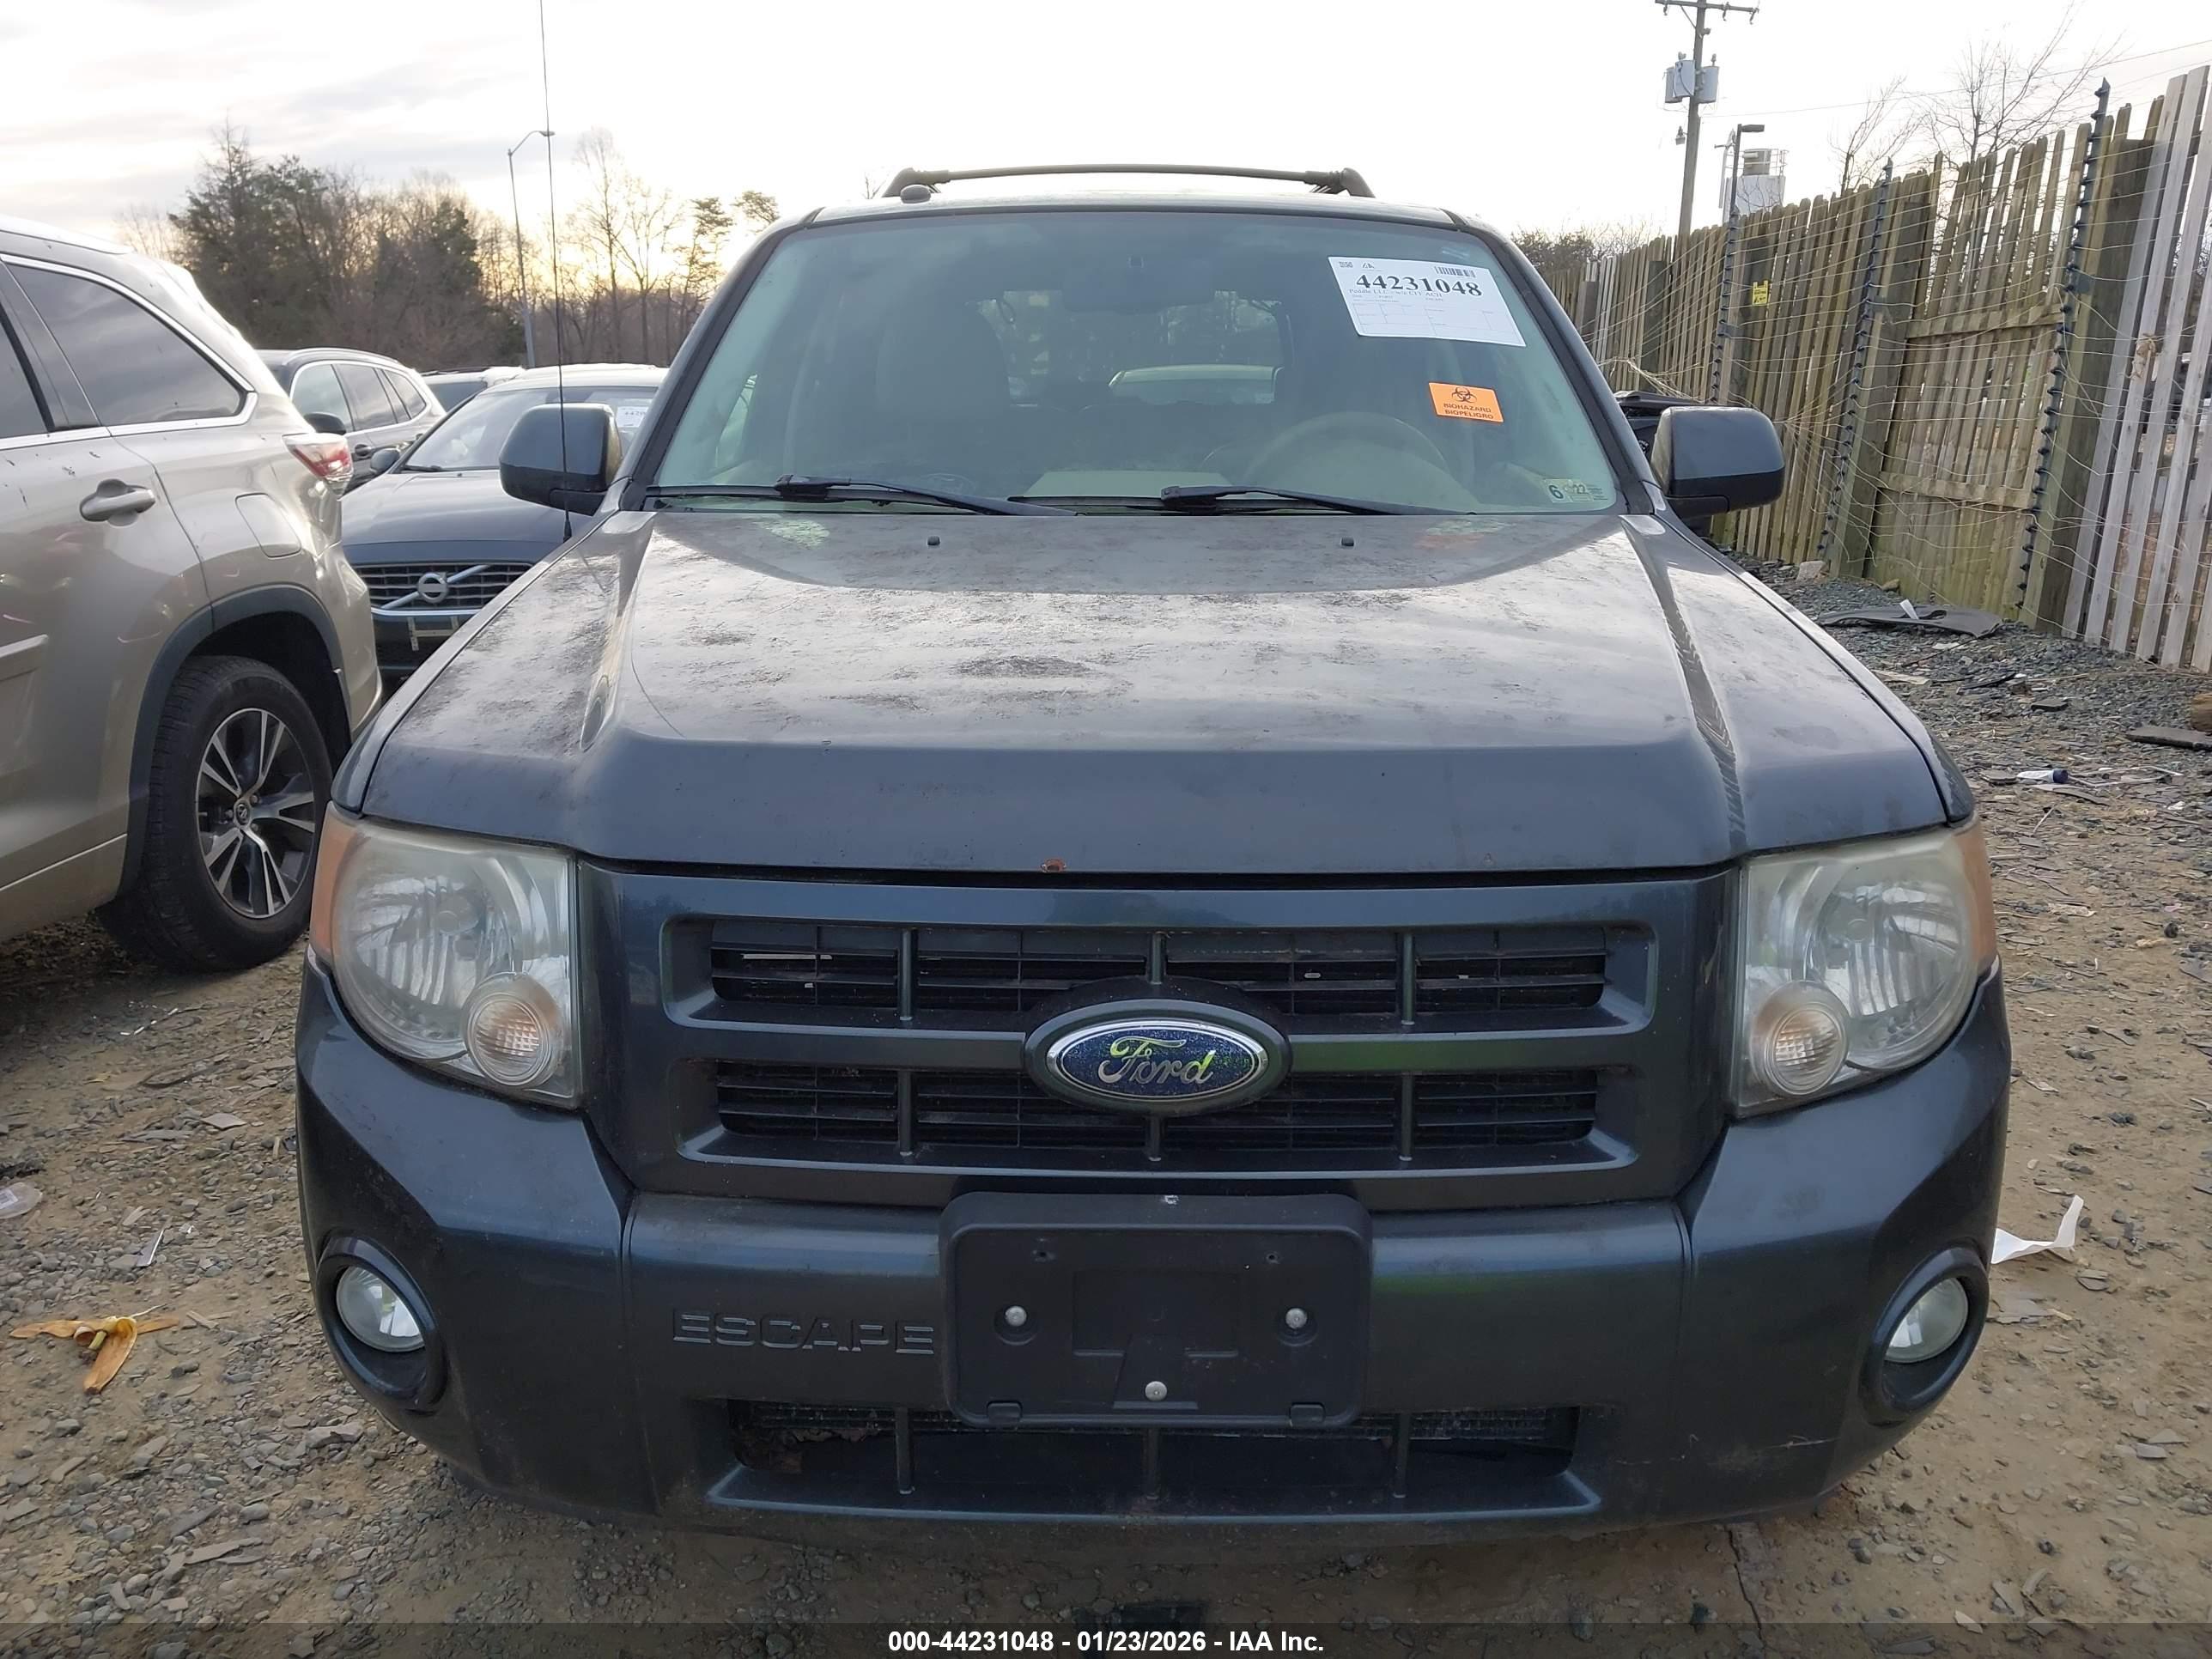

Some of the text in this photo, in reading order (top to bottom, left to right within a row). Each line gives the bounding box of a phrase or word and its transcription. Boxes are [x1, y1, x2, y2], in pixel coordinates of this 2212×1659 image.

[1356, 274, 1482, 296] 44231048
[1443, 403, 1492, 413] BIOHAZARD
[1444, 410, 1494, 419] BIOPELIGRO
[1548, 485, 1564, 499] 6
[1097, 1035, 1217, 1085] Ford
[673, 1309, 934, 1354] ESCAPE
